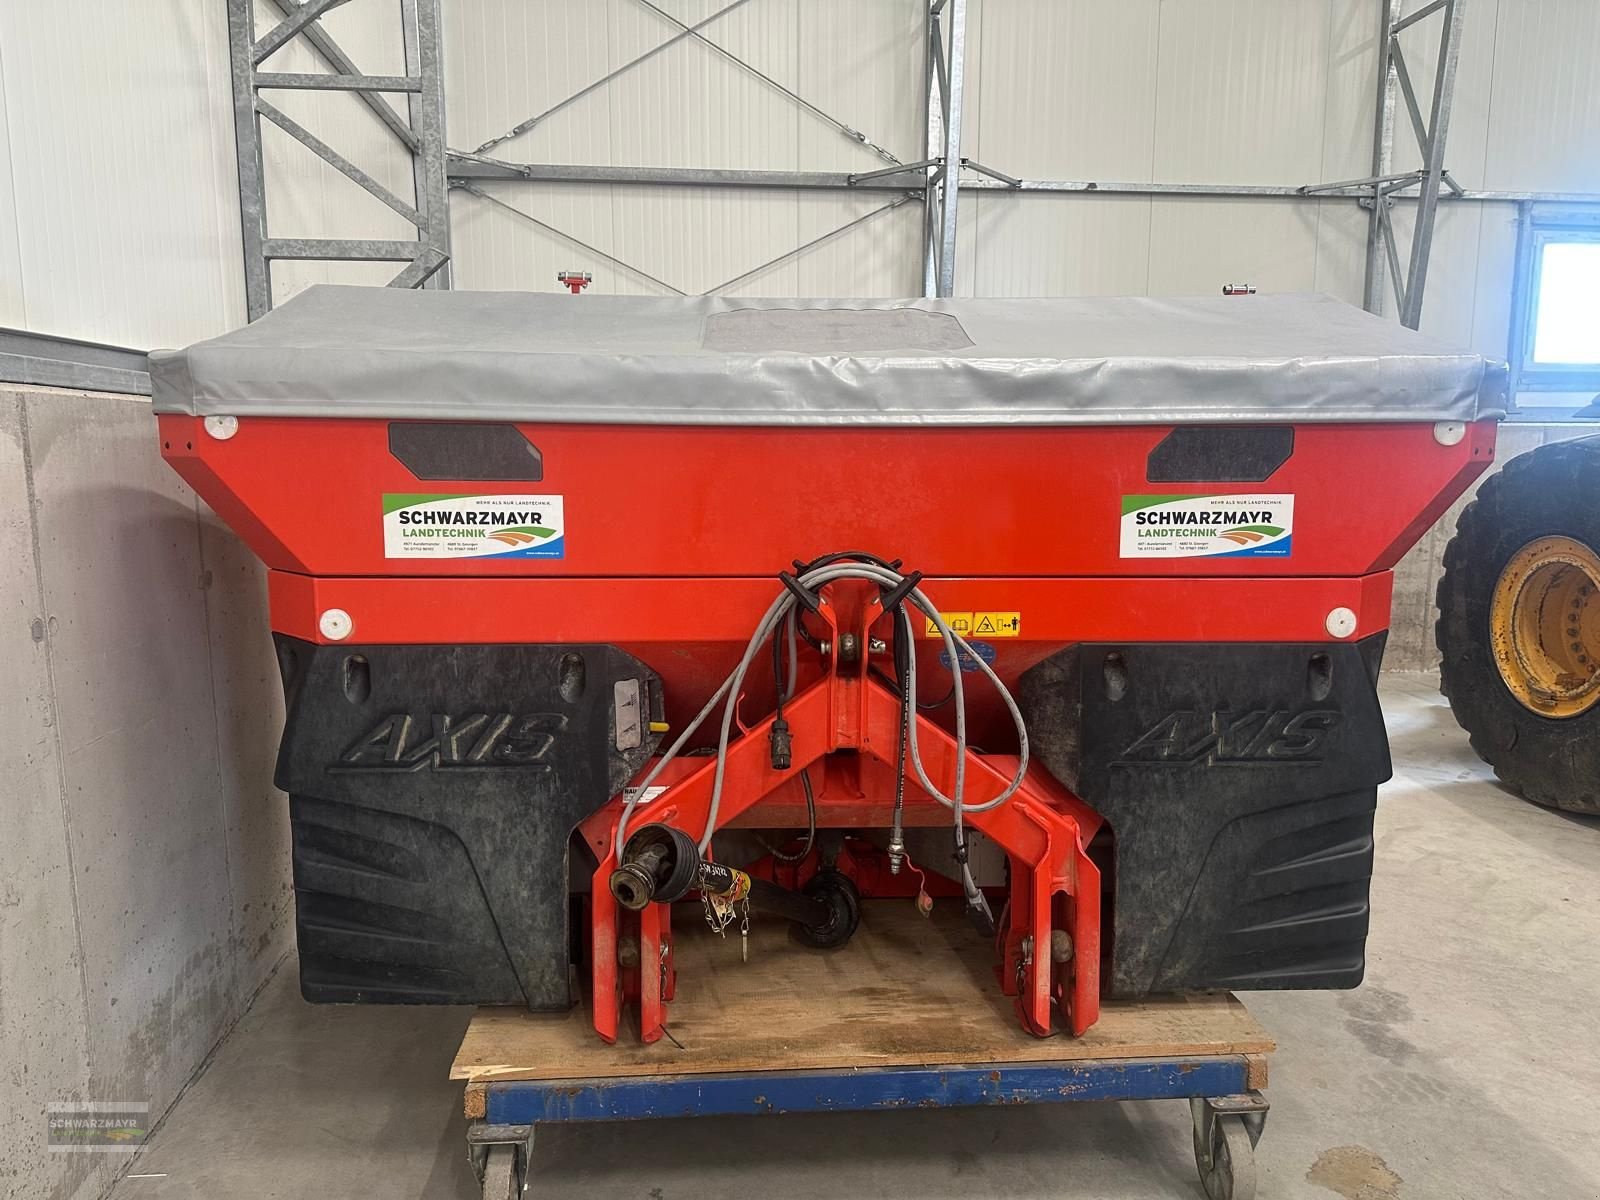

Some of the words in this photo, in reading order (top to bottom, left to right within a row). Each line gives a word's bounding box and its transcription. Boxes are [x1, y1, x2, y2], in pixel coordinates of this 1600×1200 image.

[399, 510, 542, 525] SCHWARZMAYR
[1136, 512, 1272, 526] SCHWARZMAYR
[402, 528, 486, 538] LANDTECHNIK
[1138, 528, 1217, 538] LANDTECHNIK
[337, 712, 569, 768] AXIS
[1116, 710, 1343, 766] AXIS
